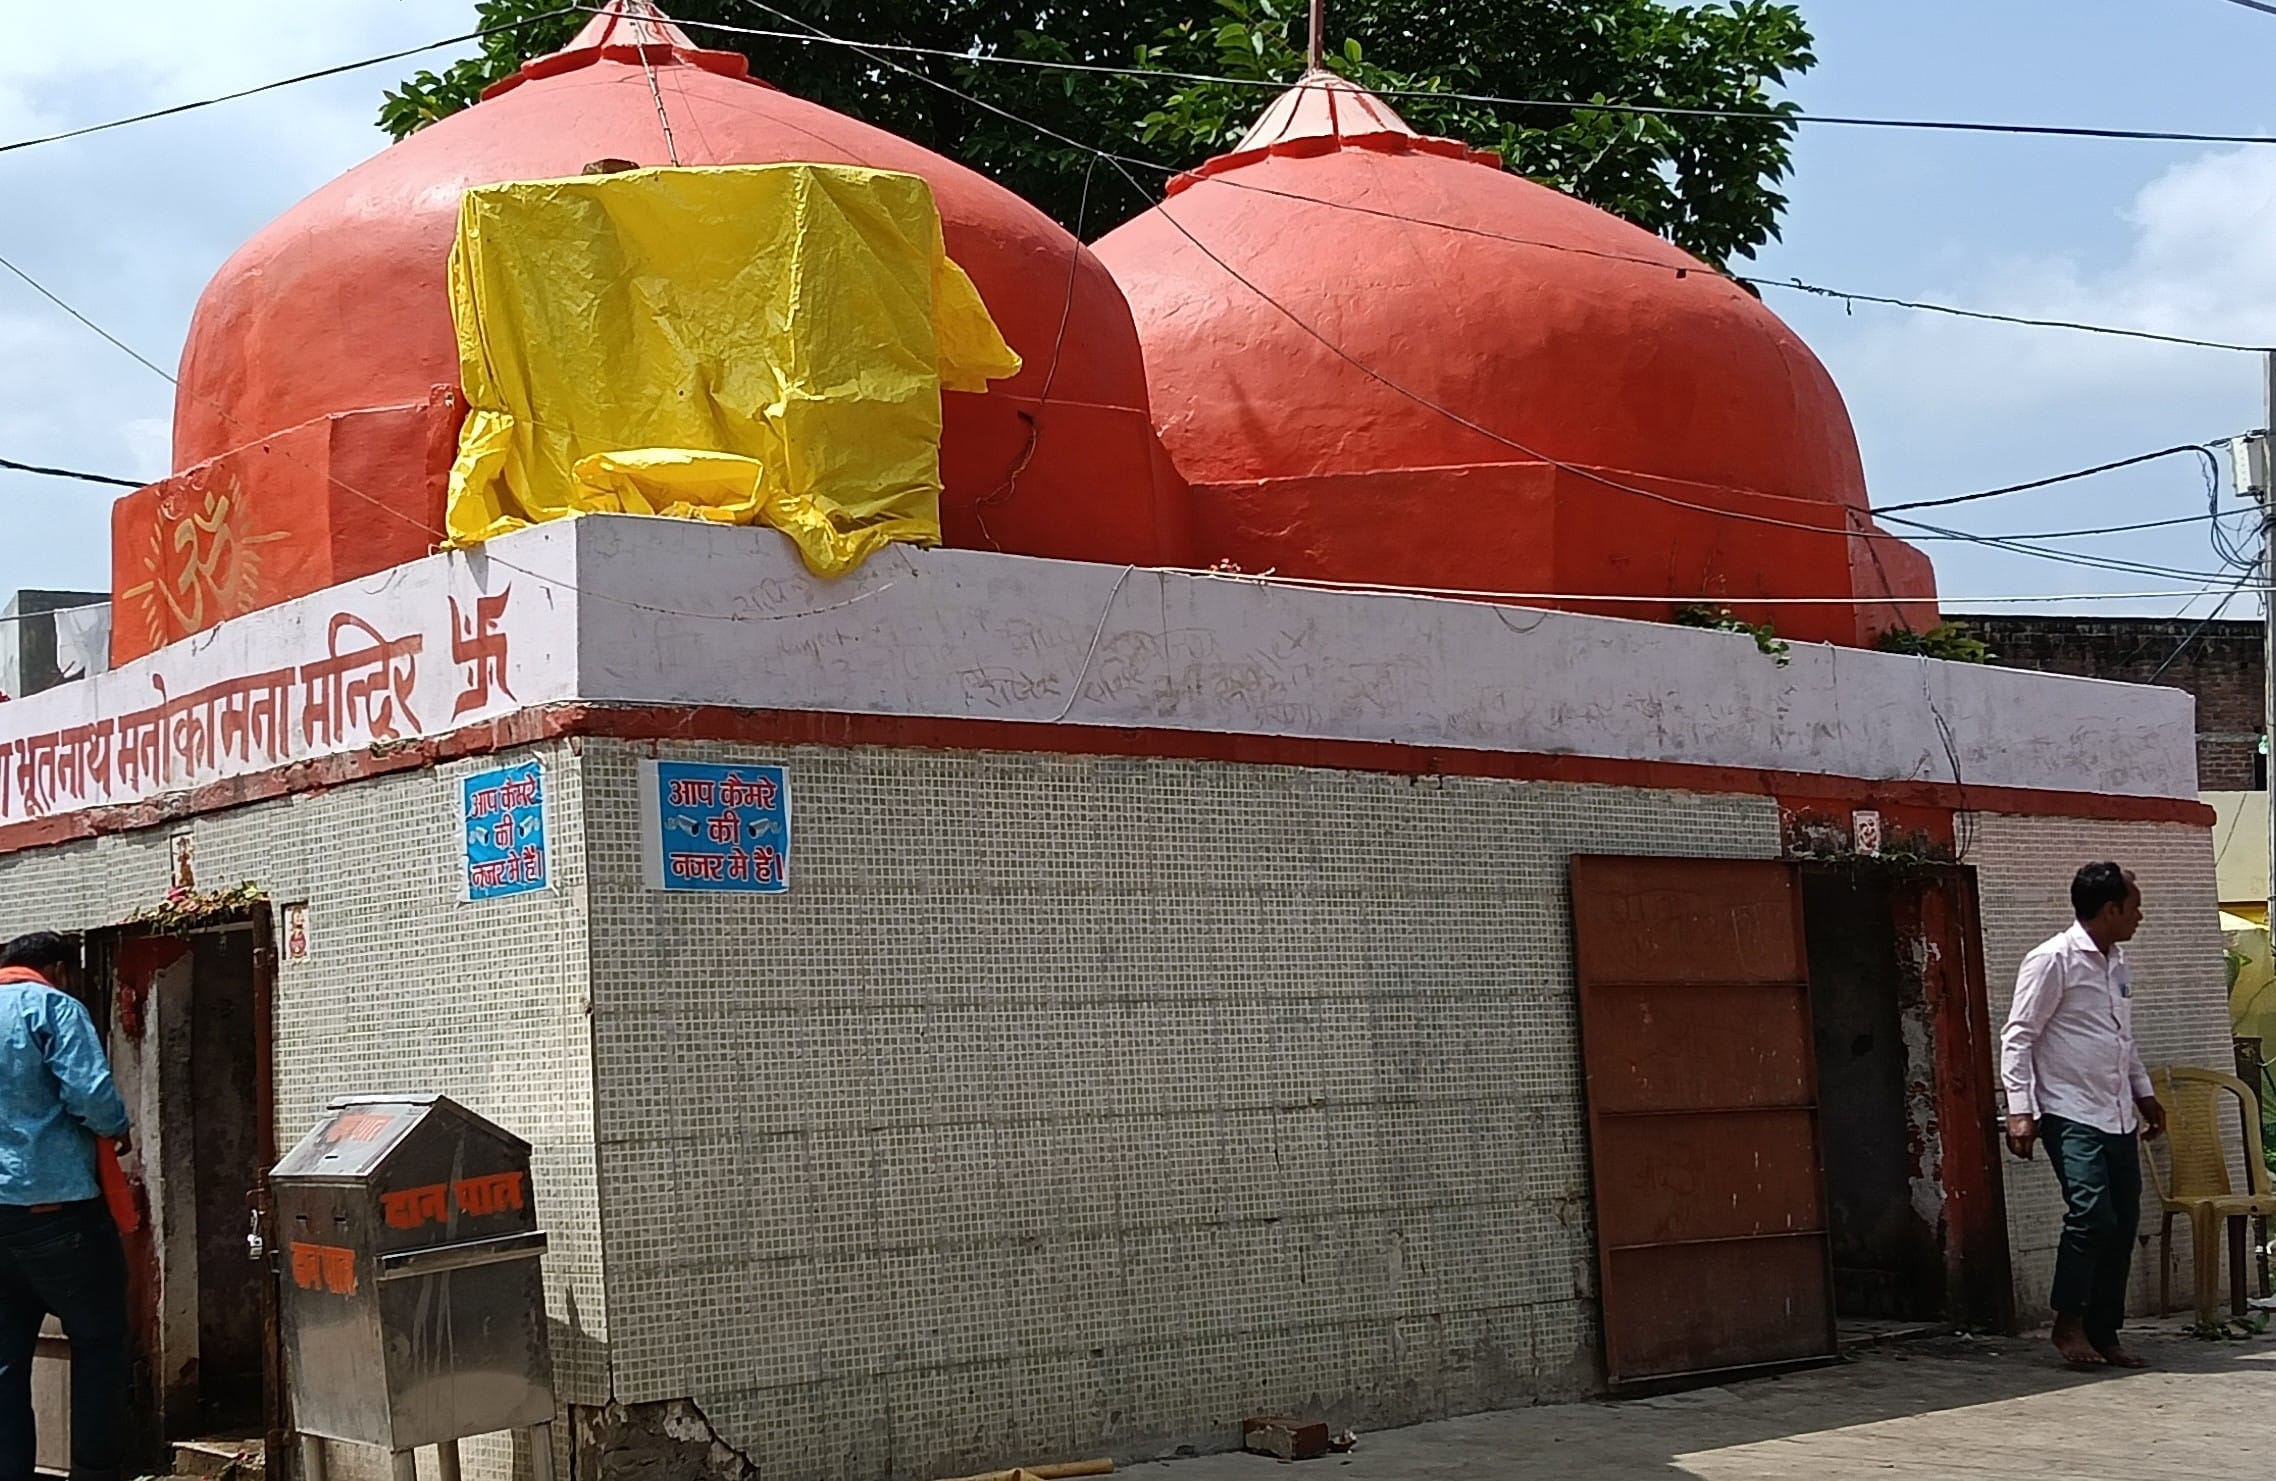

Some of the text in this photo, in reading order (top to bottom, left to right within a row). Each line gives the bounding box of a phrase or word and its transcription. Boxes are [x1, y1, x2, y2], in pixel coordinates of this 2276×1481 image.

[118, 673, 296, 794] मनोकामना
[300, 612, 423, 748] मन्दिर
[471, 773, 536, 817] आप कैमरे
[669, 772, 777, 809] आप कैमरे
[494, 813, 514, 848] की
[706, 809, 740, 844] की
[471, 861, 506, 888] नजर
[670, 852, 725, 880] नजर
